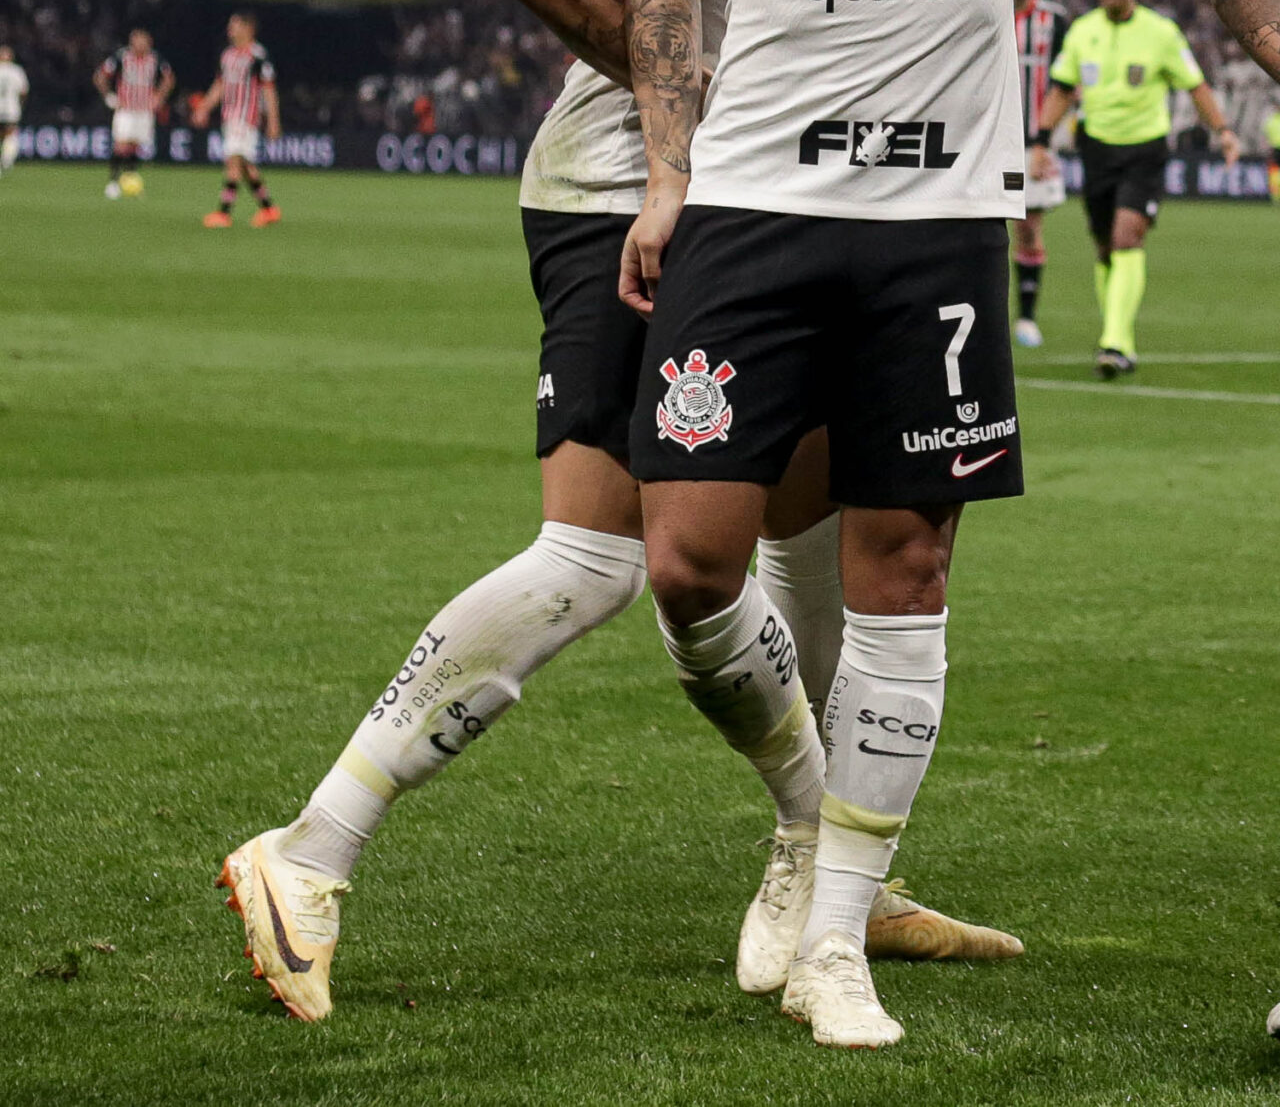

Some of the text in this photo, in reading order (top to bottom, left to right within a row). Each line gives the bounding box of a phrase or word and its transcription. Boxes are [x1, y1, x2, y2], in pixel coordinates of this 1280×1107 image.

[169, 127, 192, 161] E
[938, 302, 976, 397] 7
[902, 416, 1017, 453] UniCesumar
[370, 631, 446, 722] TODOS
[824, 675, 849, 735] Cartão
[856, 708, 938, 743] SCCP
